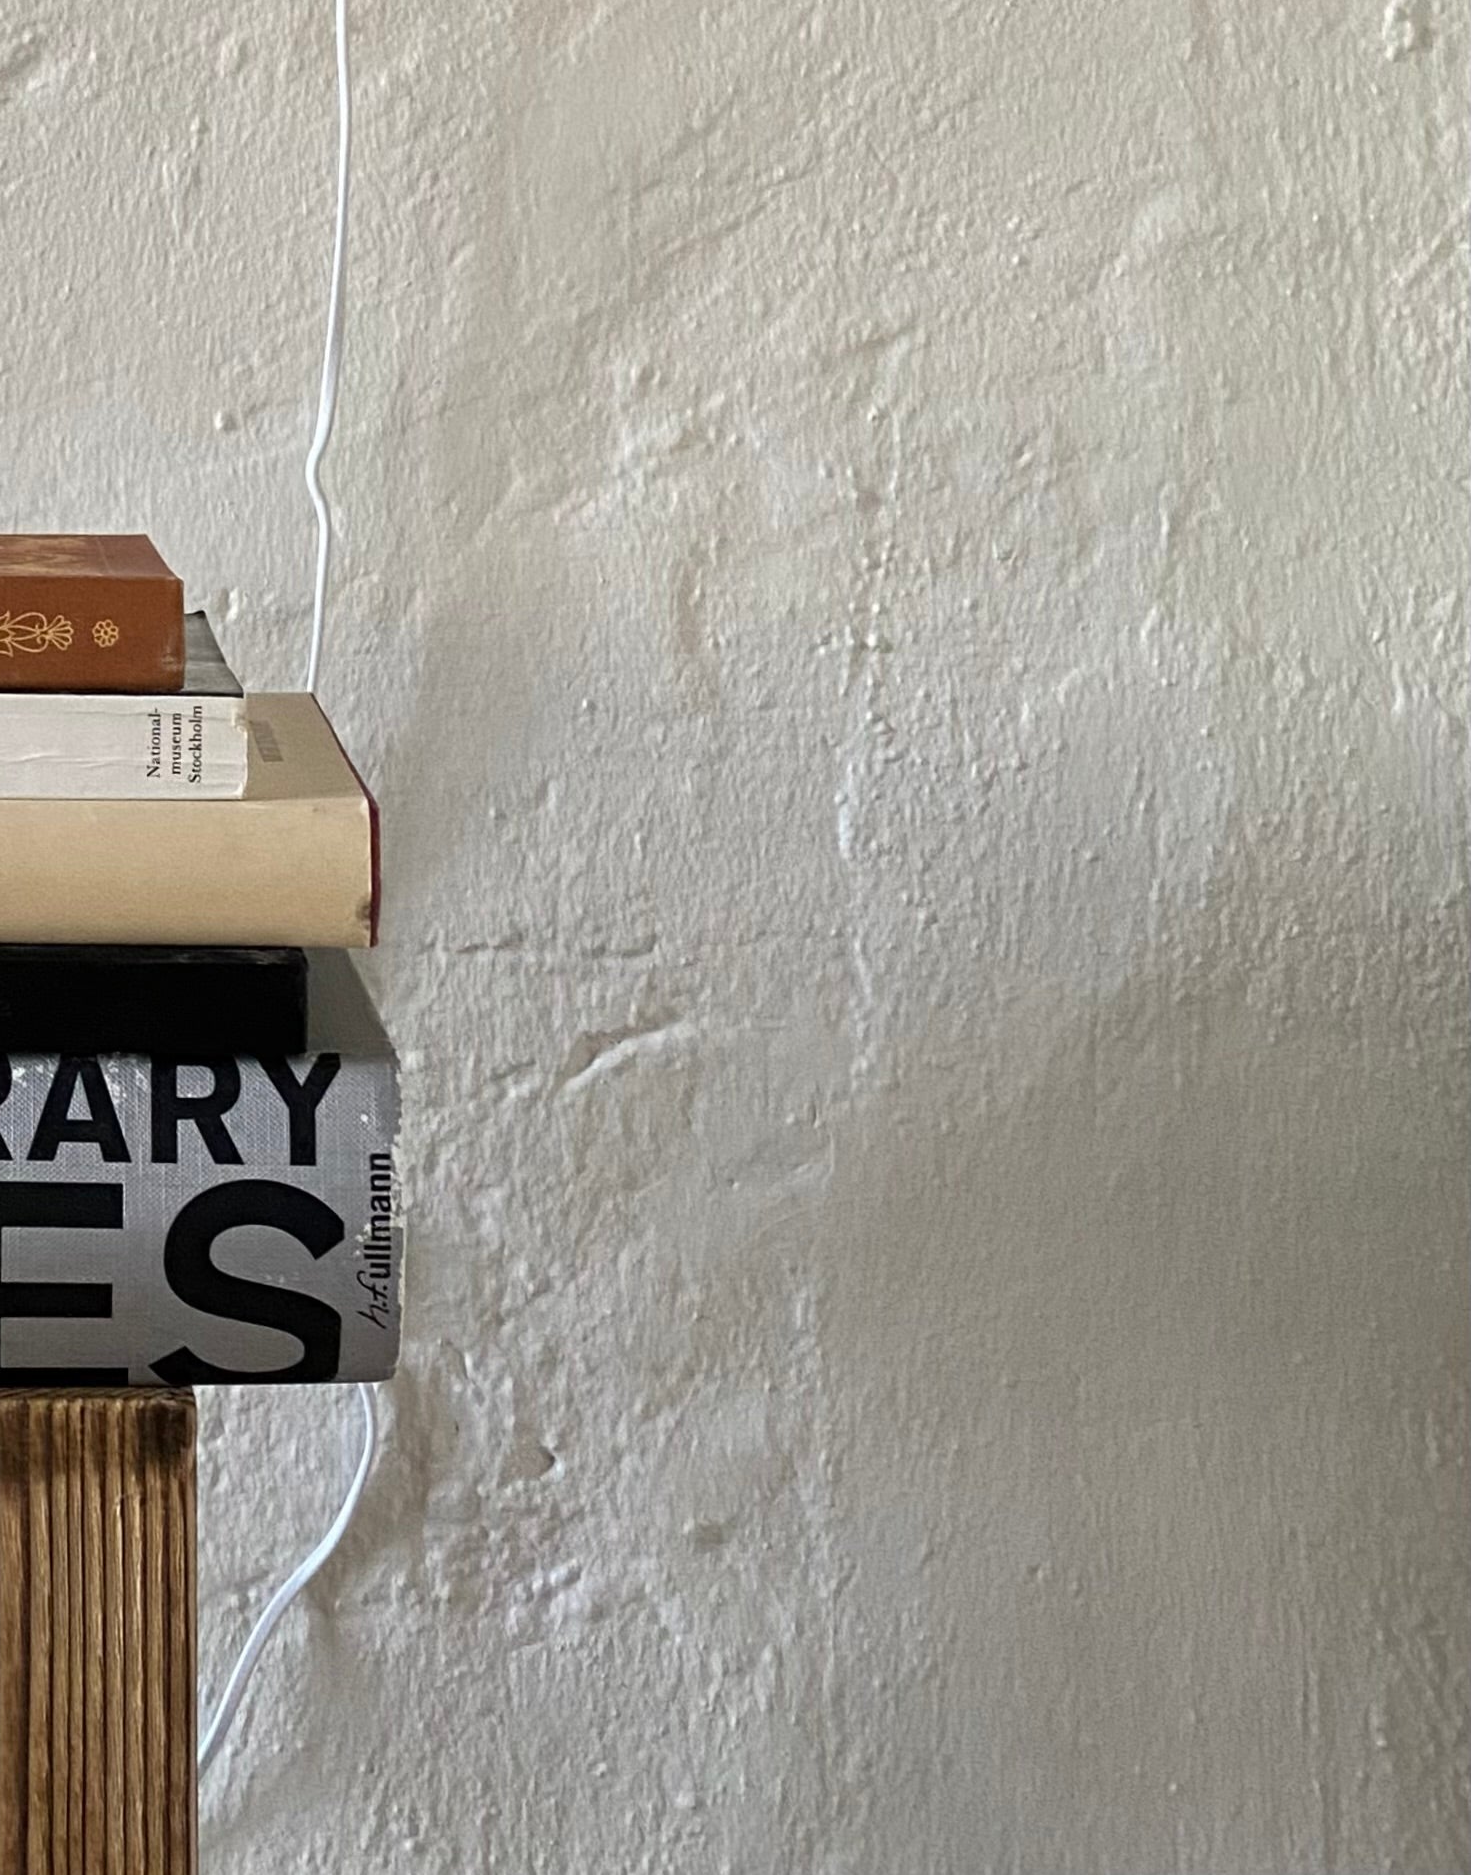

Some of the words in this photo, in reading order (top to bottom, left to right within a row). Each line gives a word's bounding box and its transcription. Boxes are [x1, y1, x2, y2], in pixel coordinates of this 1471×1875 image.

[146, 707, 162, 779] National-
[171, 712, 183, 776] museum
[187, 705, 203, 784] Stockholm
